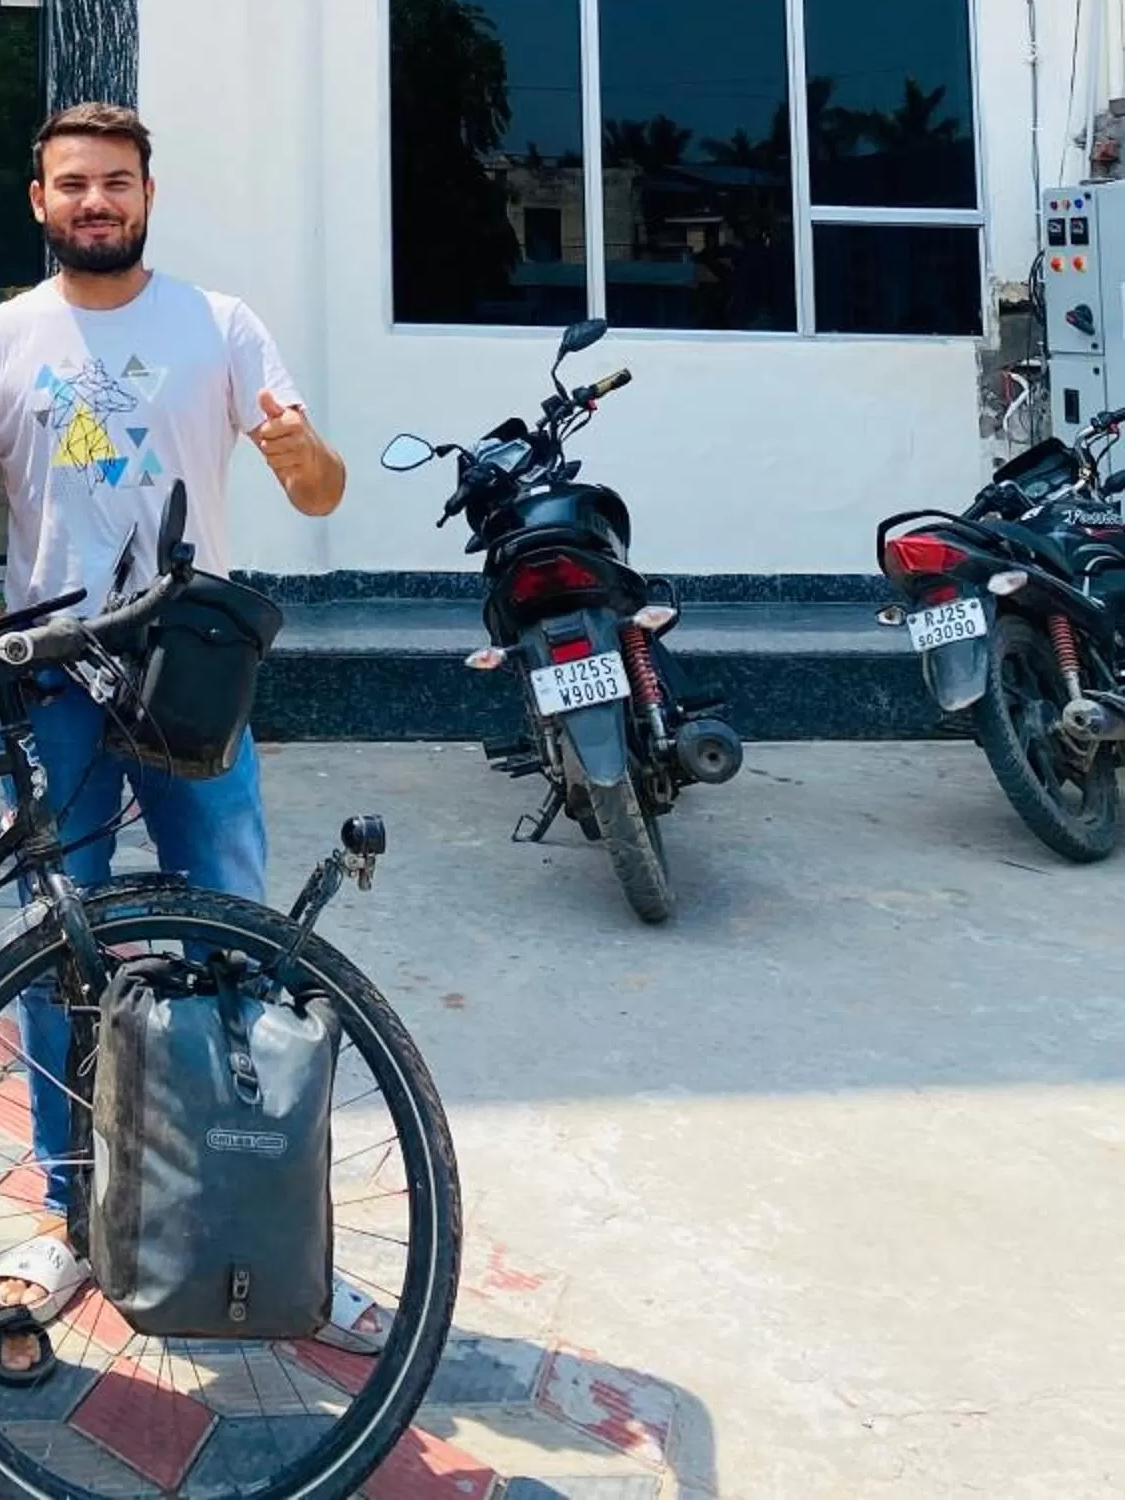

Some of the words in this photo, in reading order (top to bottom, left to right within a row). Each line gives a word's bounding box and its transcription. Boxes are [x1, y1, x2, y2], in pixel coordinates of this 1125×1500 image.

[924, 603, 967, 627] RJ25
[554, 656, 612, 686] RJ25S
[558, 677, 619, 707] W9003
